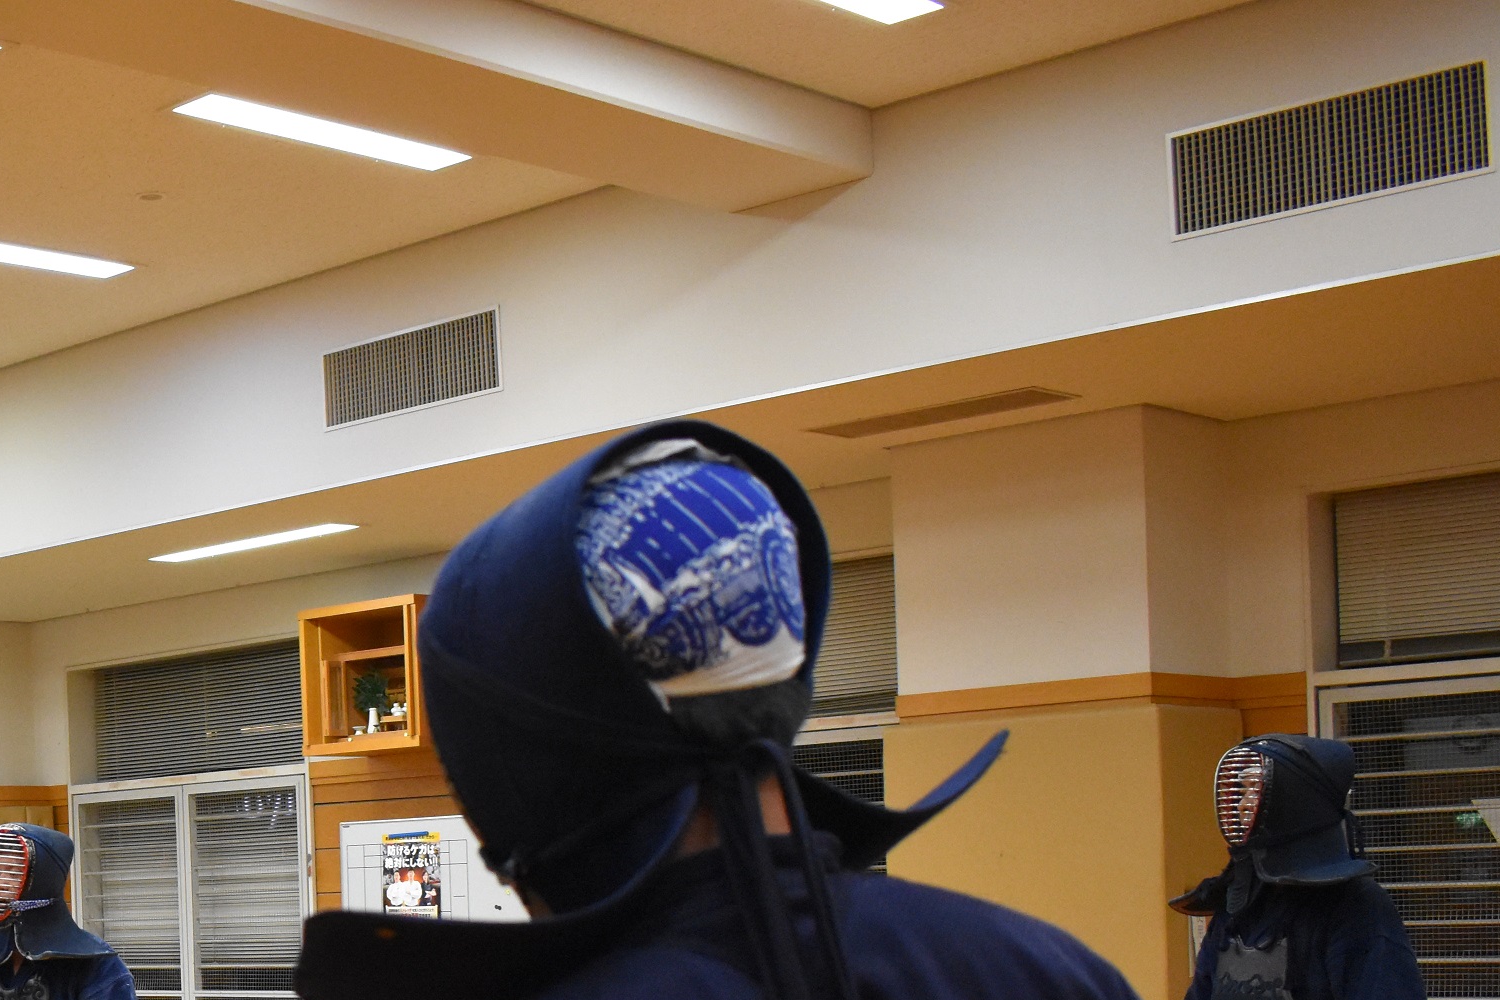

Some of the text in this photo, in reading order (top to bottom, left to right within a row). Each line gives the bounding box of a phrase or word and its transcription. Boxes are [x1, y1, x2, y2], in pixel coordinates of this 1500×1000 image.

[387, 844, 435, 856] 防げるケガは
